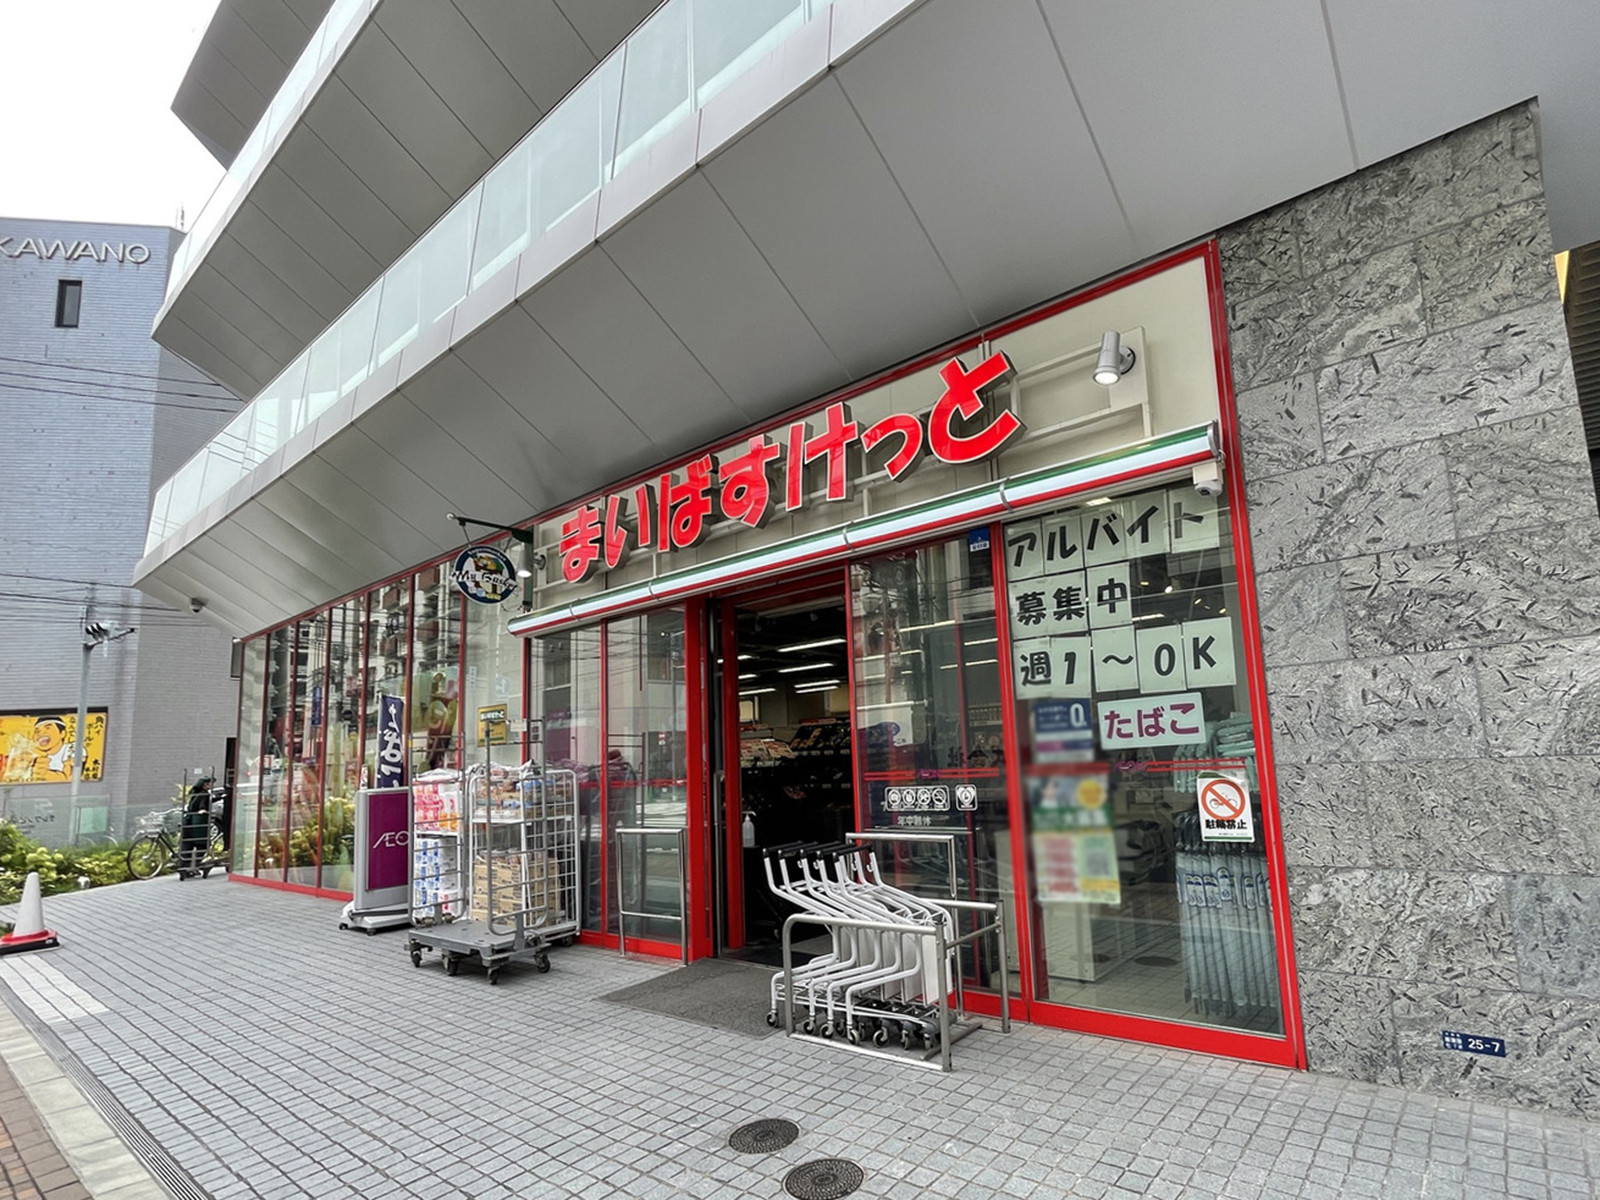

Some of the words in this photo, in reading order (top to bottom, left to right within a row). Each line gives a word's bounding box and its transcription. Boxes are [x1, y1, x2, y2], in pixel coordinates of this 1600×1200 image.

[558, 348, 1023, 584] まいばすけっと
[1007, 502, 1204, 568] アルバイト
[1015, 577, 1128, 626] 募集中
[1104, 702, 1200, 740] たばこ
[372, 830, 409, 849] AEO
[1205, 819, 1248, 830] 駐輪禁止
[1467, 1038, 1501, 1053] 25-7
